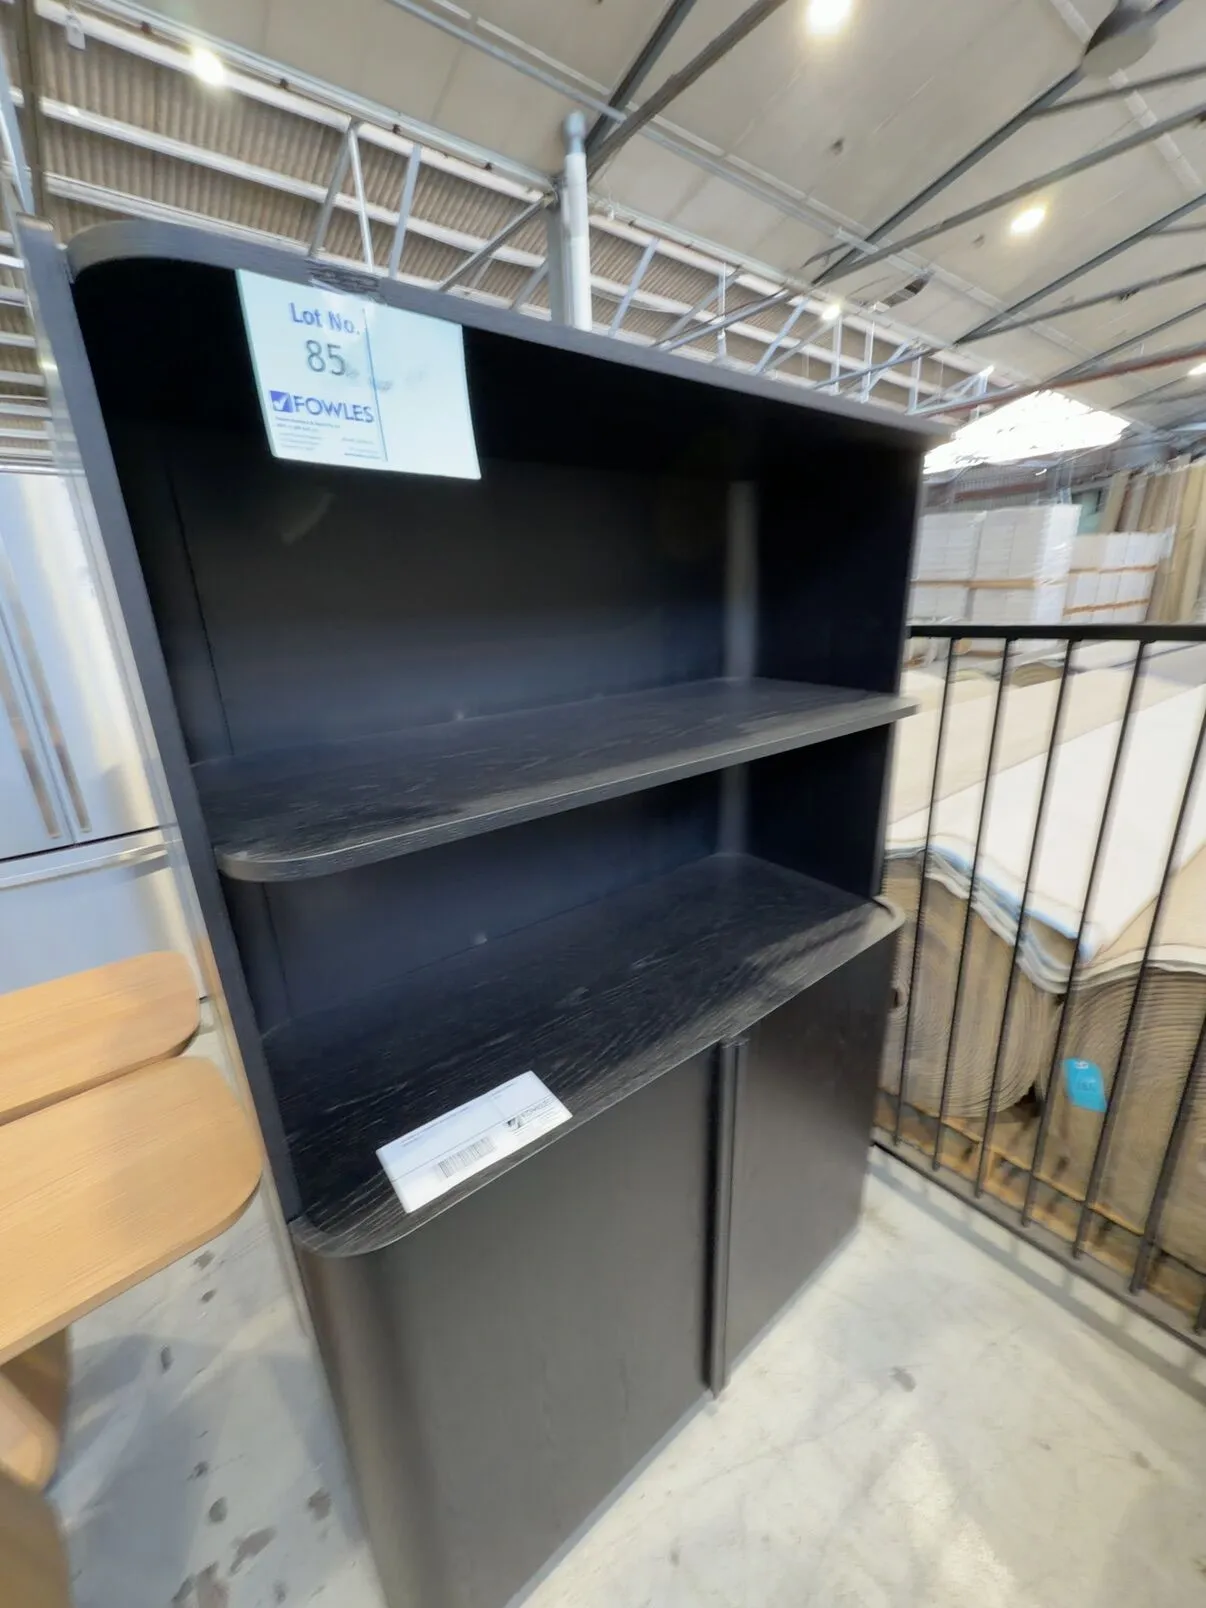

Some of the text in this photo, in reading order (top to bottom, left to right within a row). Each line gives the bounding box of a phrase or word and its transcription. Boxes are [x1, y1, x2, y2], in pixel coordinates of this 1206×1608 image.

[289, 302, 361, 335] Lot No.
[306, 339, 346, 376] 85
[294, 395, 375, 423] FOWLES
